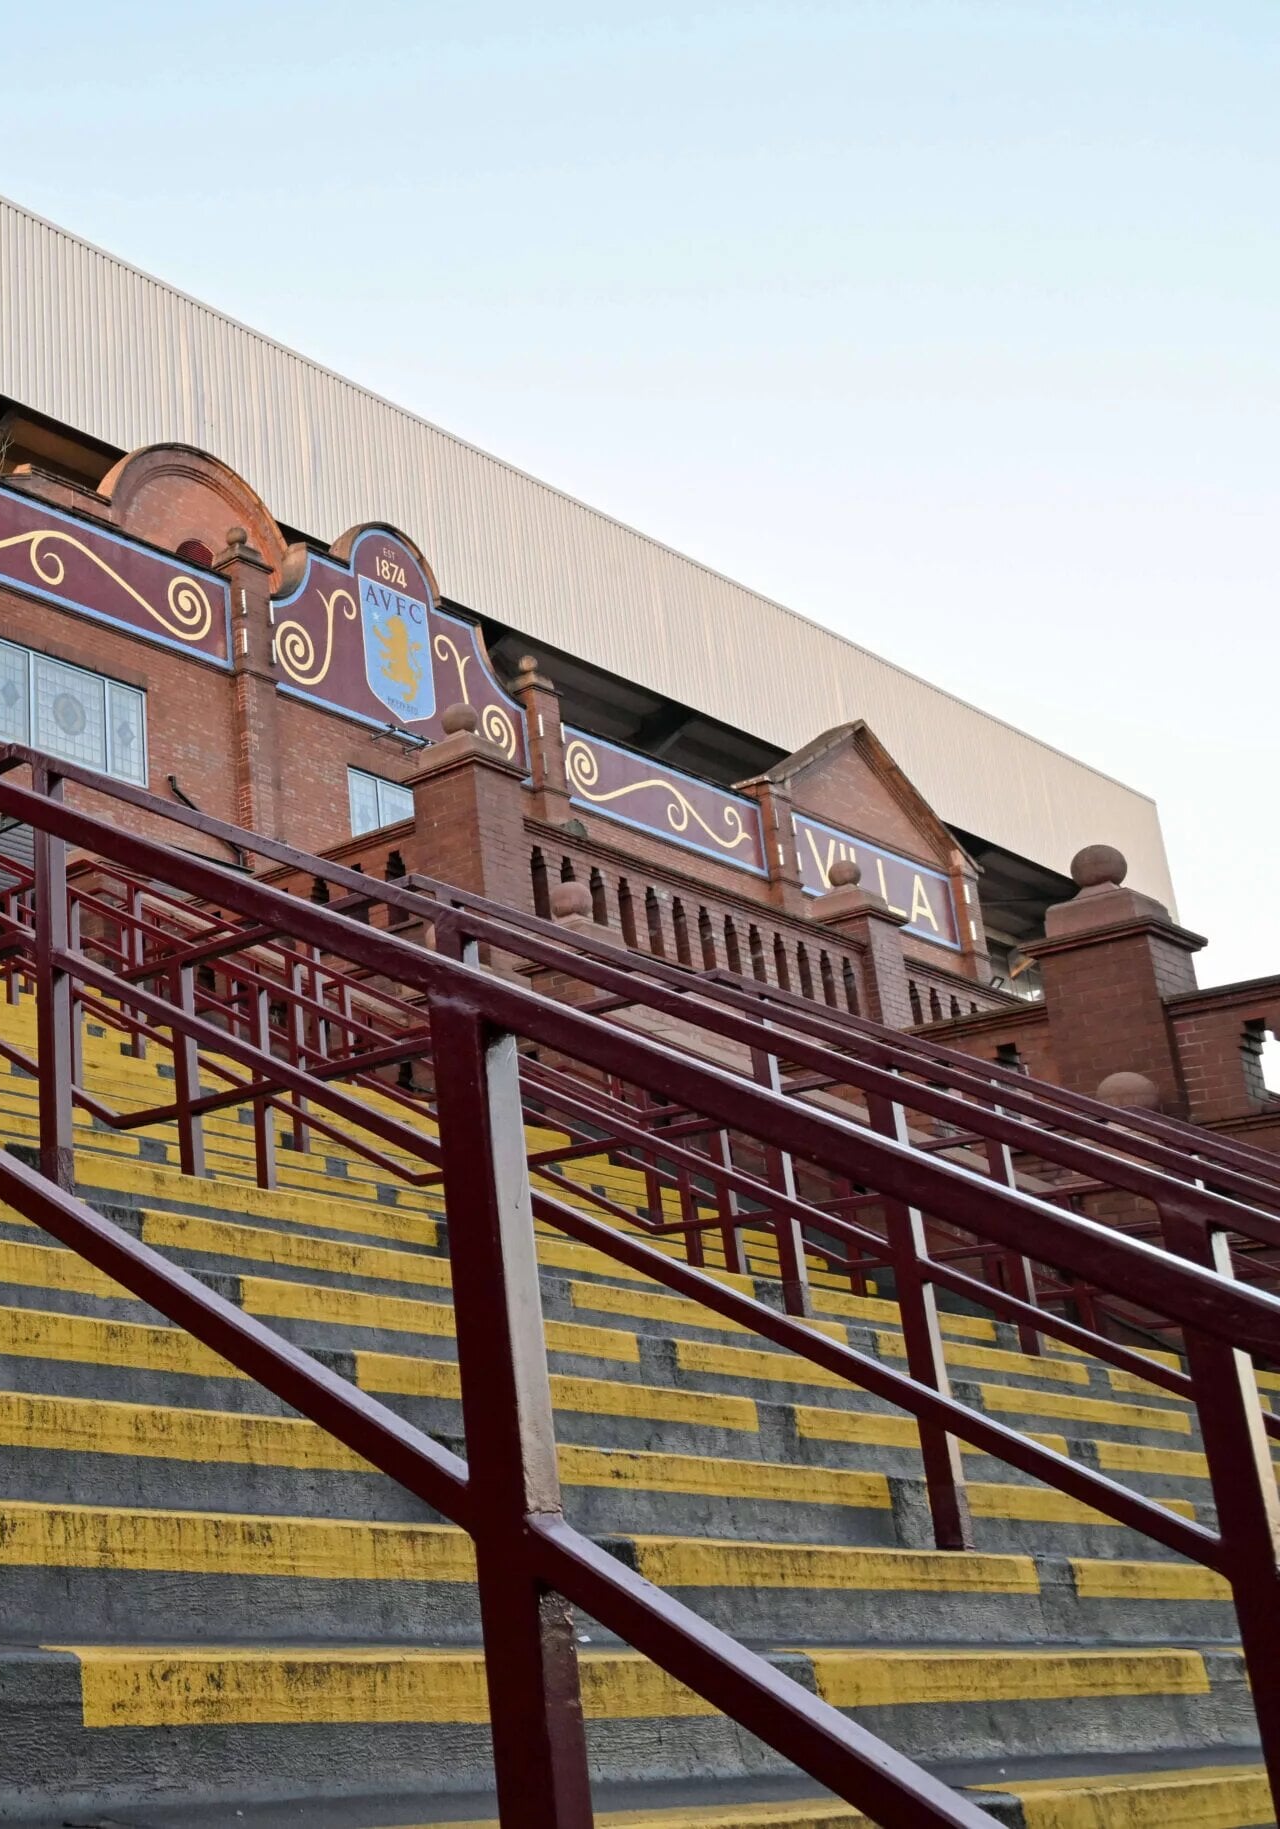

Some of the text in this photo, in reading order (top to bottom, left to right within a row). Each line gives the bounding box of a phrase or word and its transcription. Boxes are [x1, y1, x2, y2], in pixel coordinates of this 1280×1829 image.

[383, 547, 396, 561] EST
[376, 556, 408, 588] 1874
[366, 585, 422, 625] AVFC
